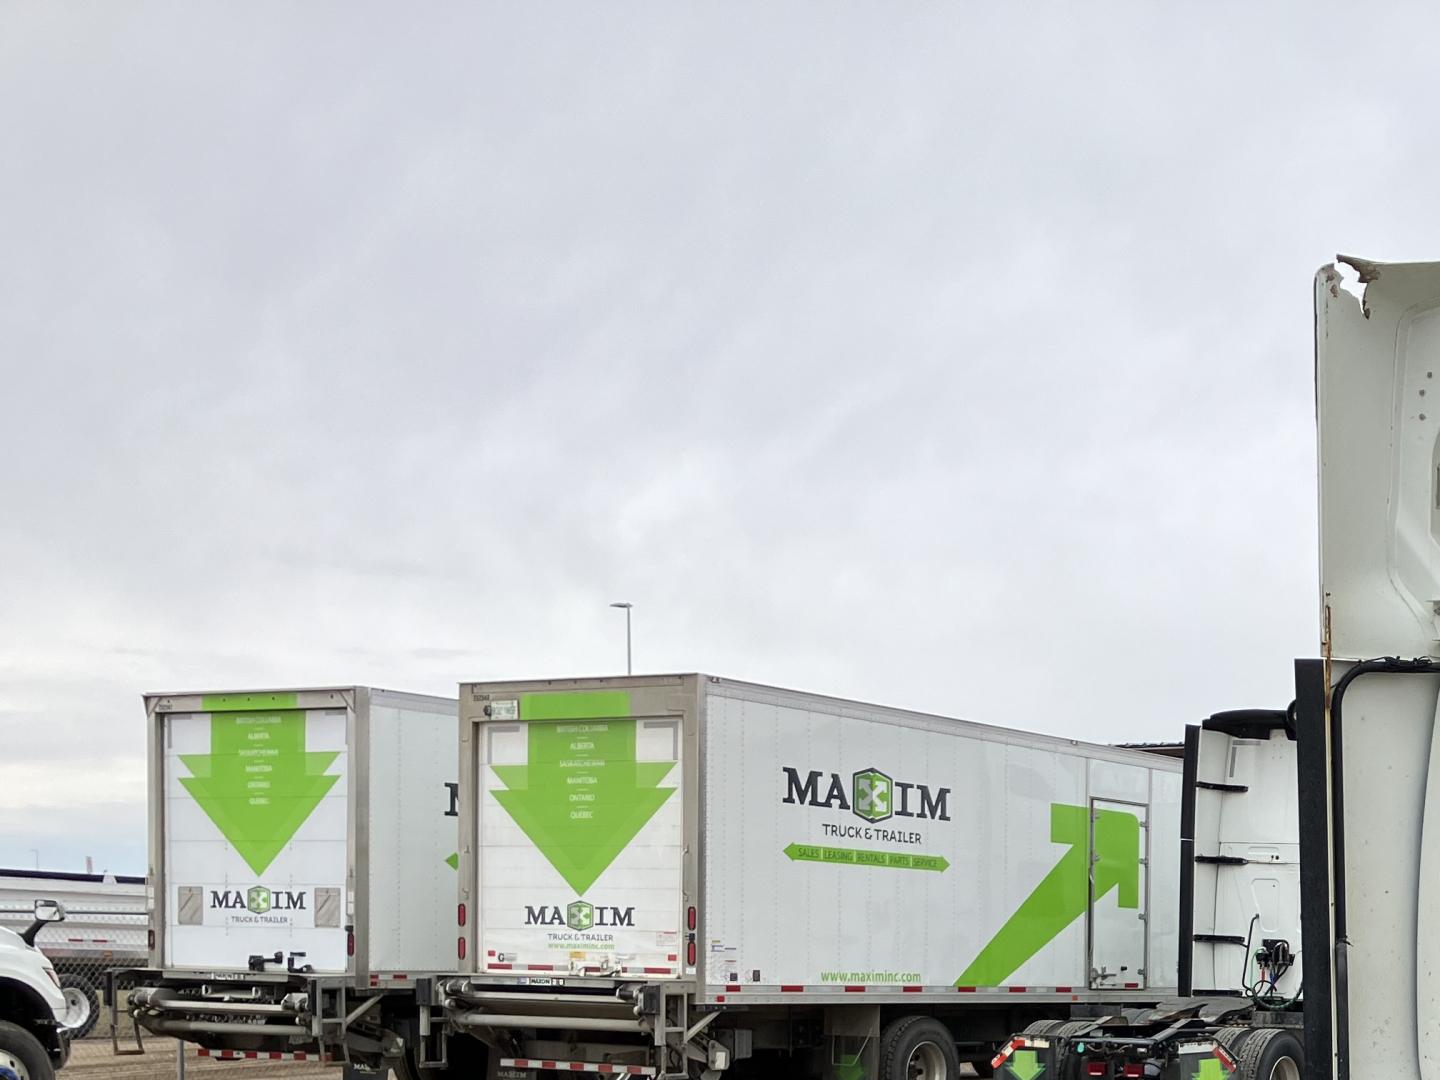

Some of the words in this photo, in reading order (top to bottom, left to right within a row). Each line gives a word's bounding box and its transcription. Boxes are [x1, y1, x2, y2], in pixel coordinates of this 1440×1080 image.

[569, 742, 595, 750] ALBERTA
[566, 776, 598, 785] MANITOBA
[568, 794, 595, 802] ONTARIO
[782, 767, 951, 824] MAXIM
[822, 823, 862, 839] TRUCK
[864, 828, 873, 840] &
[874, 828, 922, 844] TRAILER
[798, 847, 820, 858] SALES
[823, 849, 852, 861] LEASING
[857, 851, 885, 864] RENTALS
[889, 854, 909, 866] PARTS
[912, 856, 937, 868] SERVICE
[210, 885, 307, 914] MAXIM
[524, 900, 635, 931] MAXIM
[548, 933, 574, 941] TRUCK
[581, 934, 613, 942] TRAILER
[548, 942, 615, 950] www.maximinc.com
[820, 969, 921, 983] www.maximinc.com
